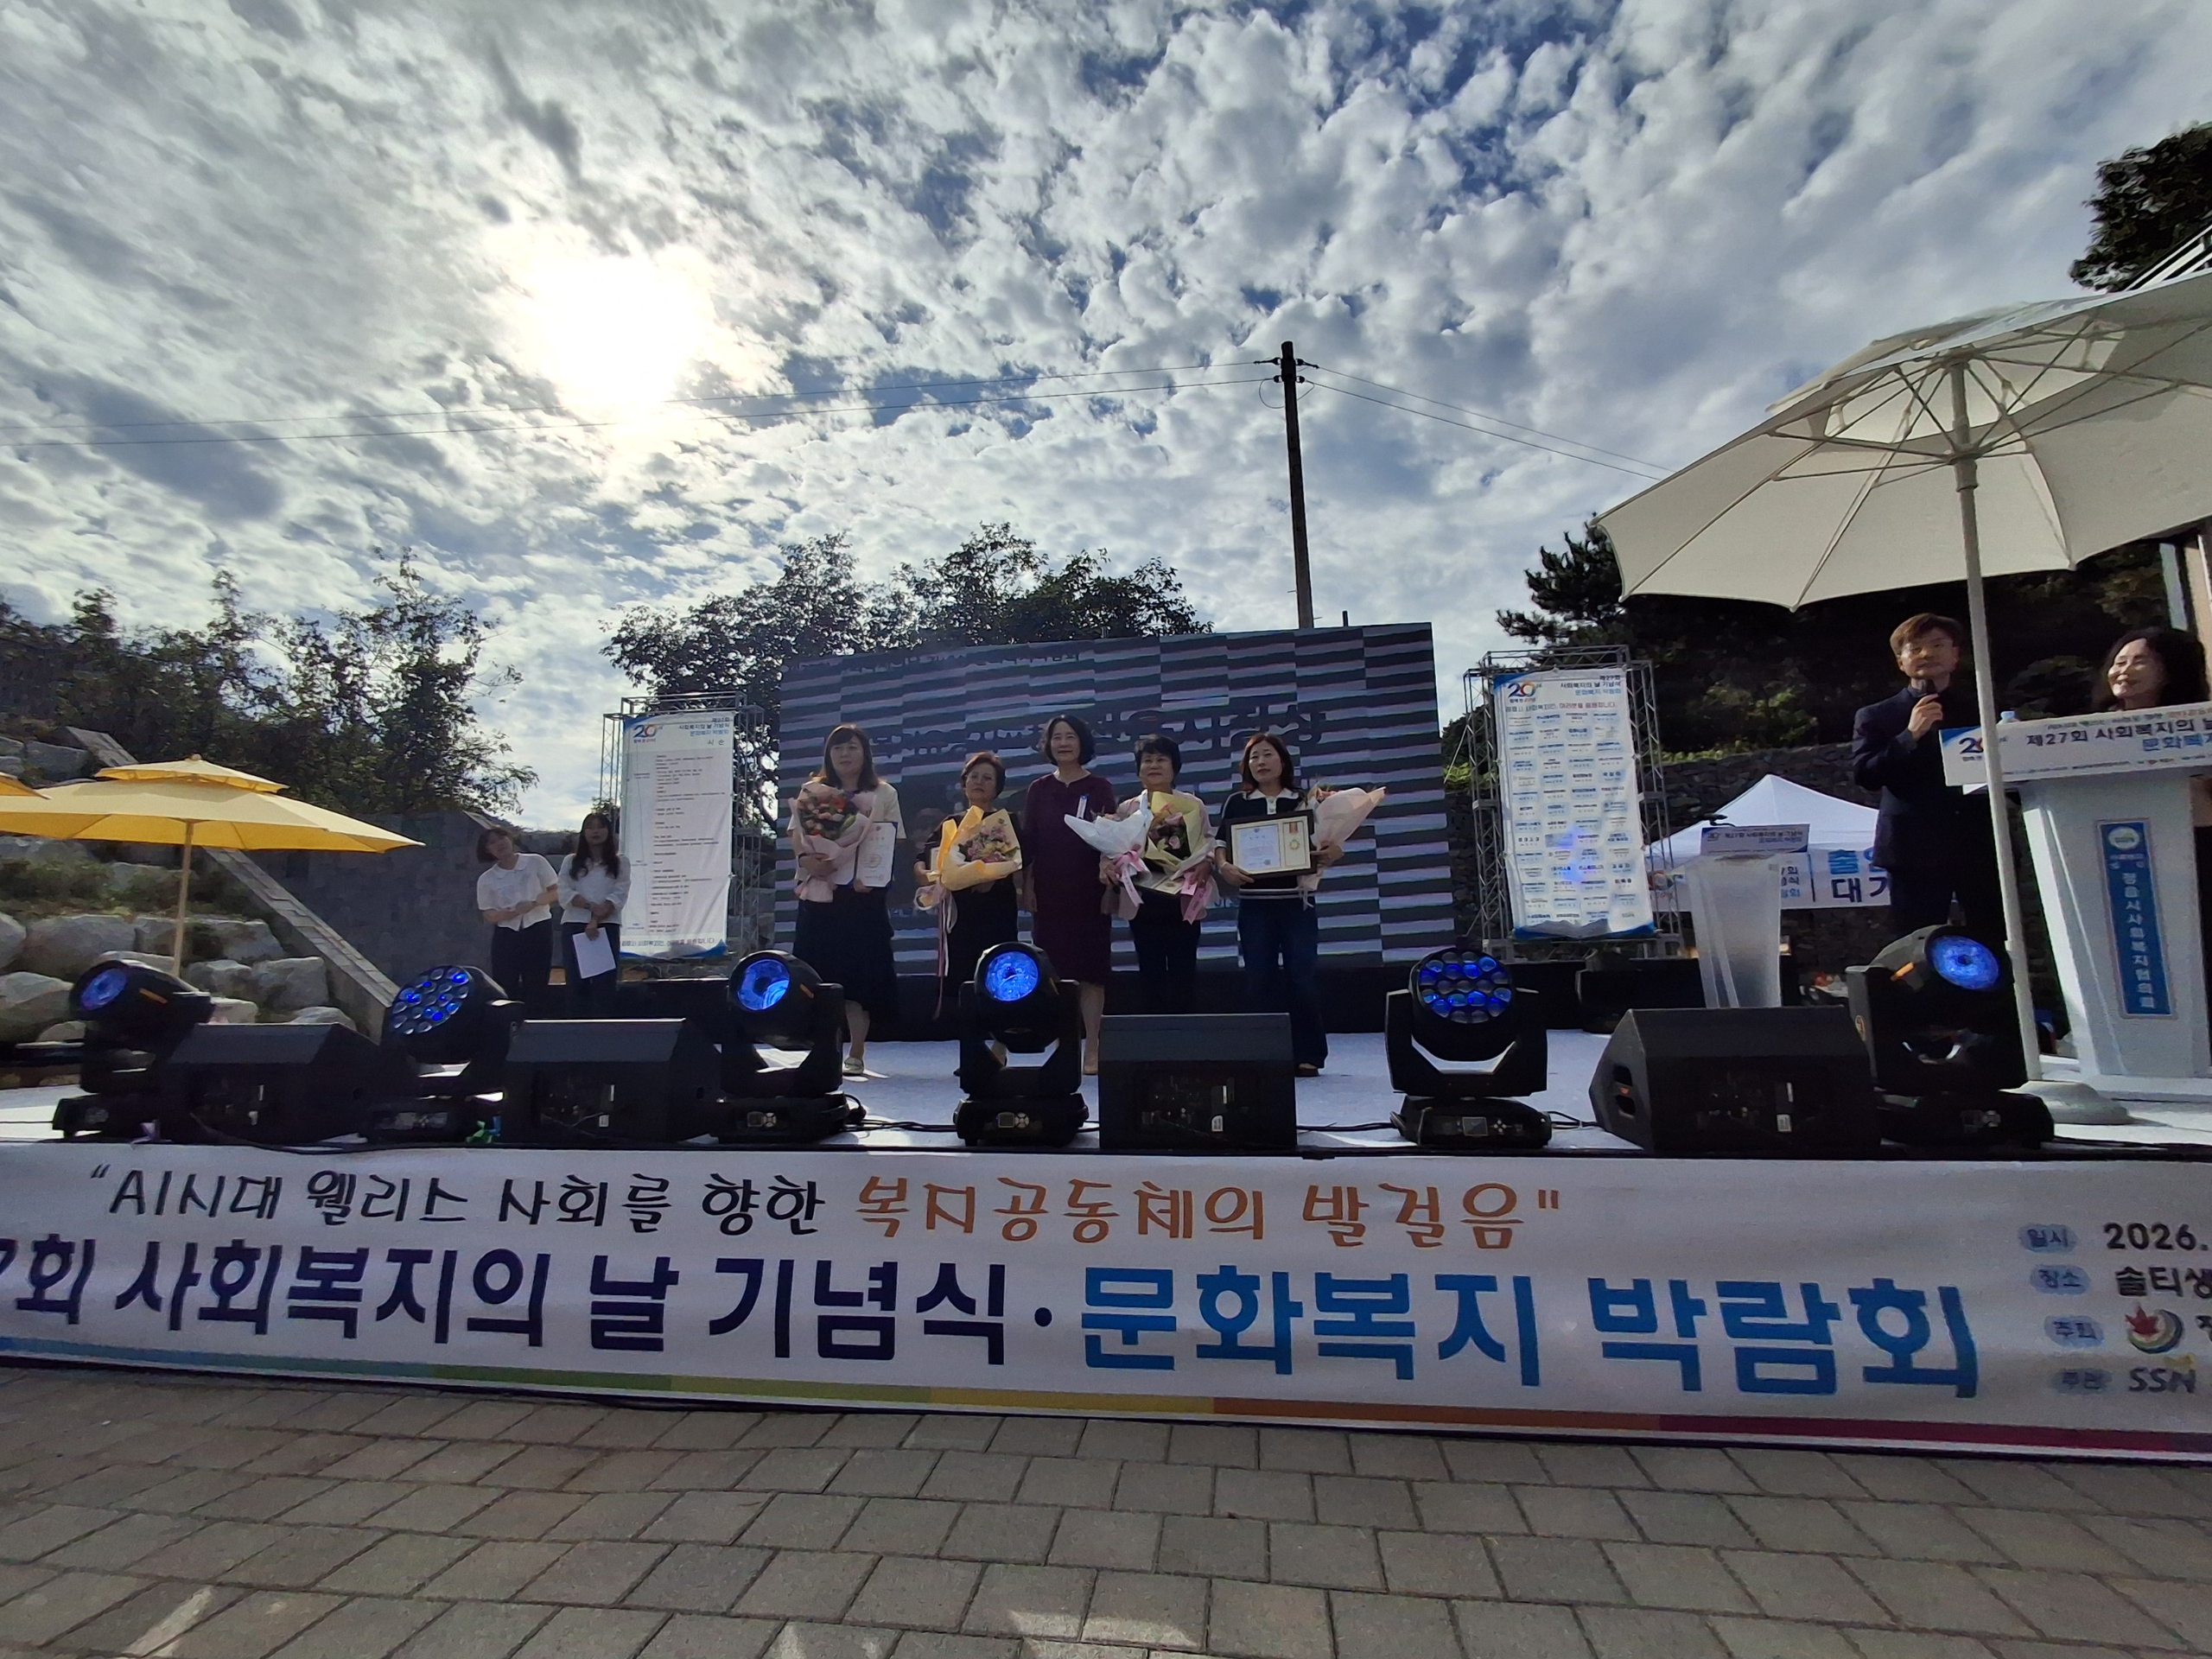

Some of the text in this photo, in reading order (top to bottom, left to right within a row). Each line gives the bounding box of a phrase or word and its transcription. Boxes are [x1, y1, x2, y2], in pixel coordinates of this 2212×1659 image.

[2026, 729, 2088, 747] 제27회
[2094, 718, 2196, 741] 사회복지의
[307, 1170, 468, 1225] 웰리스
[499, 1173, 672, 1233] 사회를
[702, 1173, 826, 1236] 향한
[855, 1175, 1264, 1243] 복지공동체의
[2027, 1223, 2209, 1251] 일시 2026.
[2038, 1269, 2082, 1288] 장소
[115, 1239, 551, 1344] 사회복지의
[589, 1255, 680, 1352] 날
[1587, 1277, 1980, 1400] 박람회
